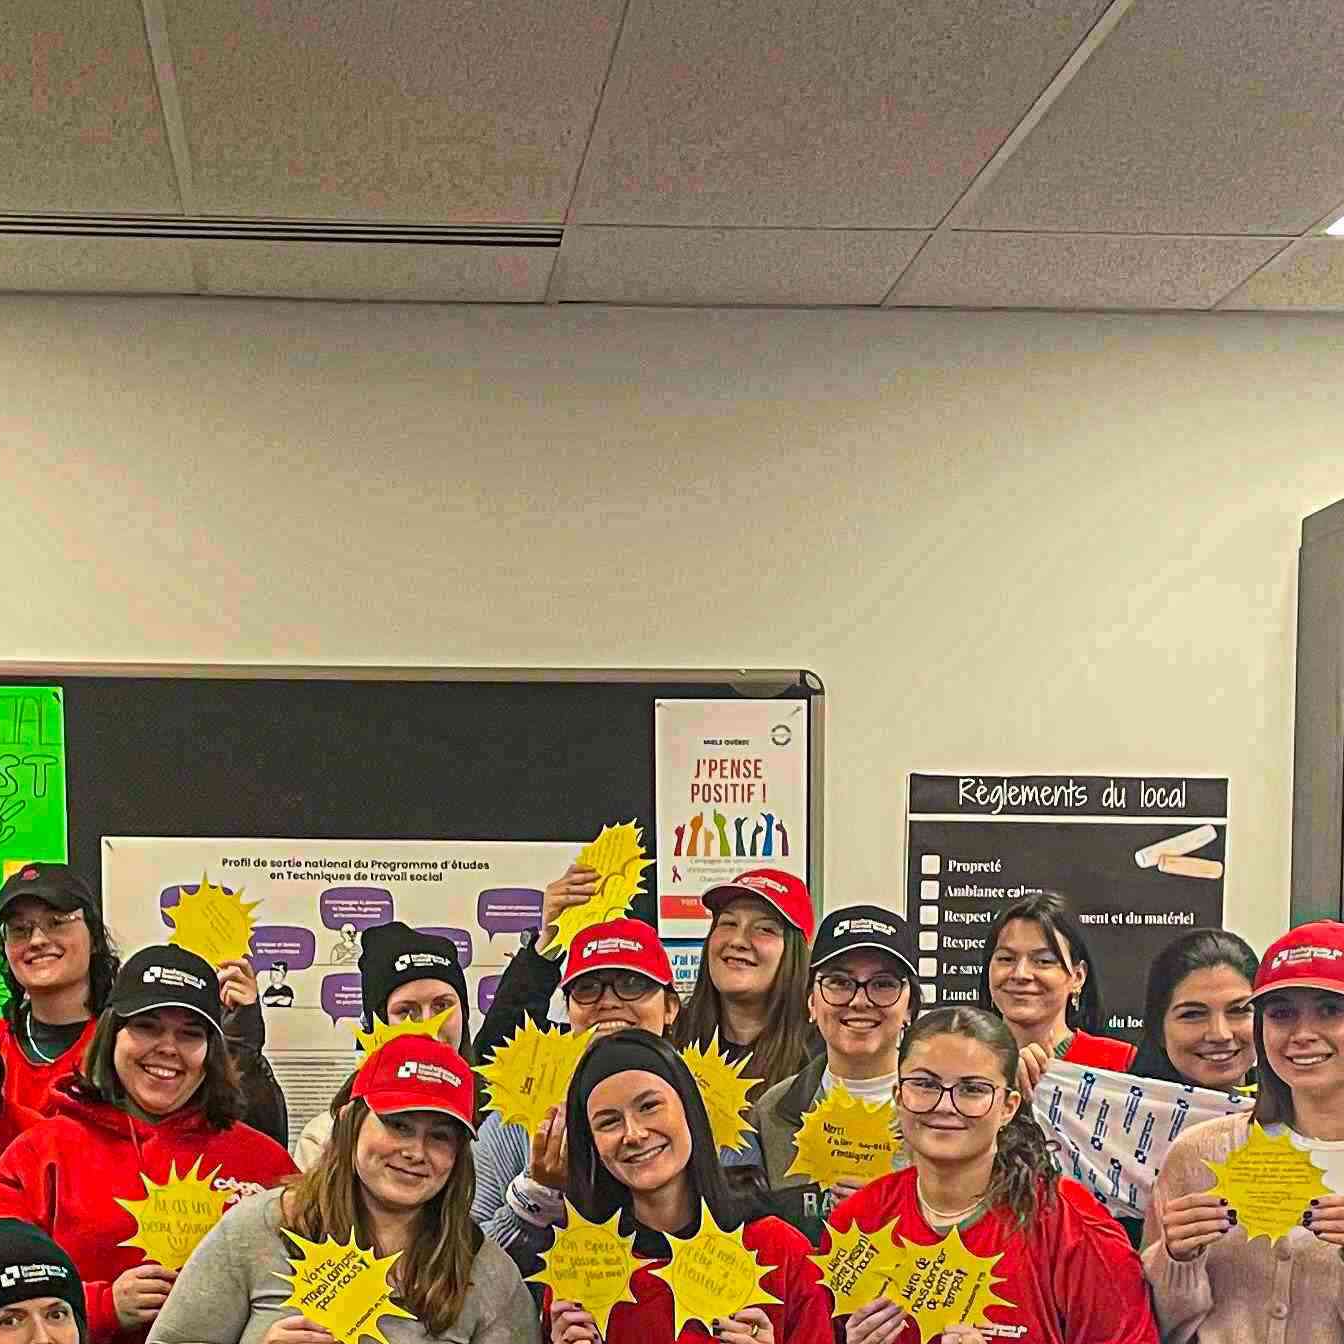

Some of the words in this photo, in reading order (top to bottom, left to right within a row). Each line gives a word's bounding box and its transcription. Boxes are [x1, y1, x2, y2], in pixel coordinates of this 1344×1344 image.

[694, 758, 763, 779] J'PENSE
[690, 783, 756, 804] POSITIF
[958, 777, 1089, 815] Règlements
[1102, 779, 1127, 809] du
[1140, 780, 1187, 809] local
[221, 857, 251, 869] Profil
[253, 857, 268, 869] de
[269, 858, 302, 870] sortie
[304, 858, 352, 870] national
[353, 858, 369, 870] du
[370, 859, 439, 873] Programme
[947, 857, 1002, 874] Propreté
[269, 872, 285, 881] en
[286, 870, 352, 884] Techniques
[353, 871, 369, 882] de
[370, 871, 408, 883] travail
[409, 872, 443, 883] social
[944, 885, 1006, 898] Ambiance
[944, 909, 992, 924] Respect
[1111, 912, 1124, 925] et
[1125, 911, 1143, 925] du
[1144, 911, 1195, 926] matériel
[942, 935, 987, 950] Respec
[942, 961, 958, 975] Le
[1108, 1015, 1126, 1030] du
[301, 1258, 336, 1285] Votre
